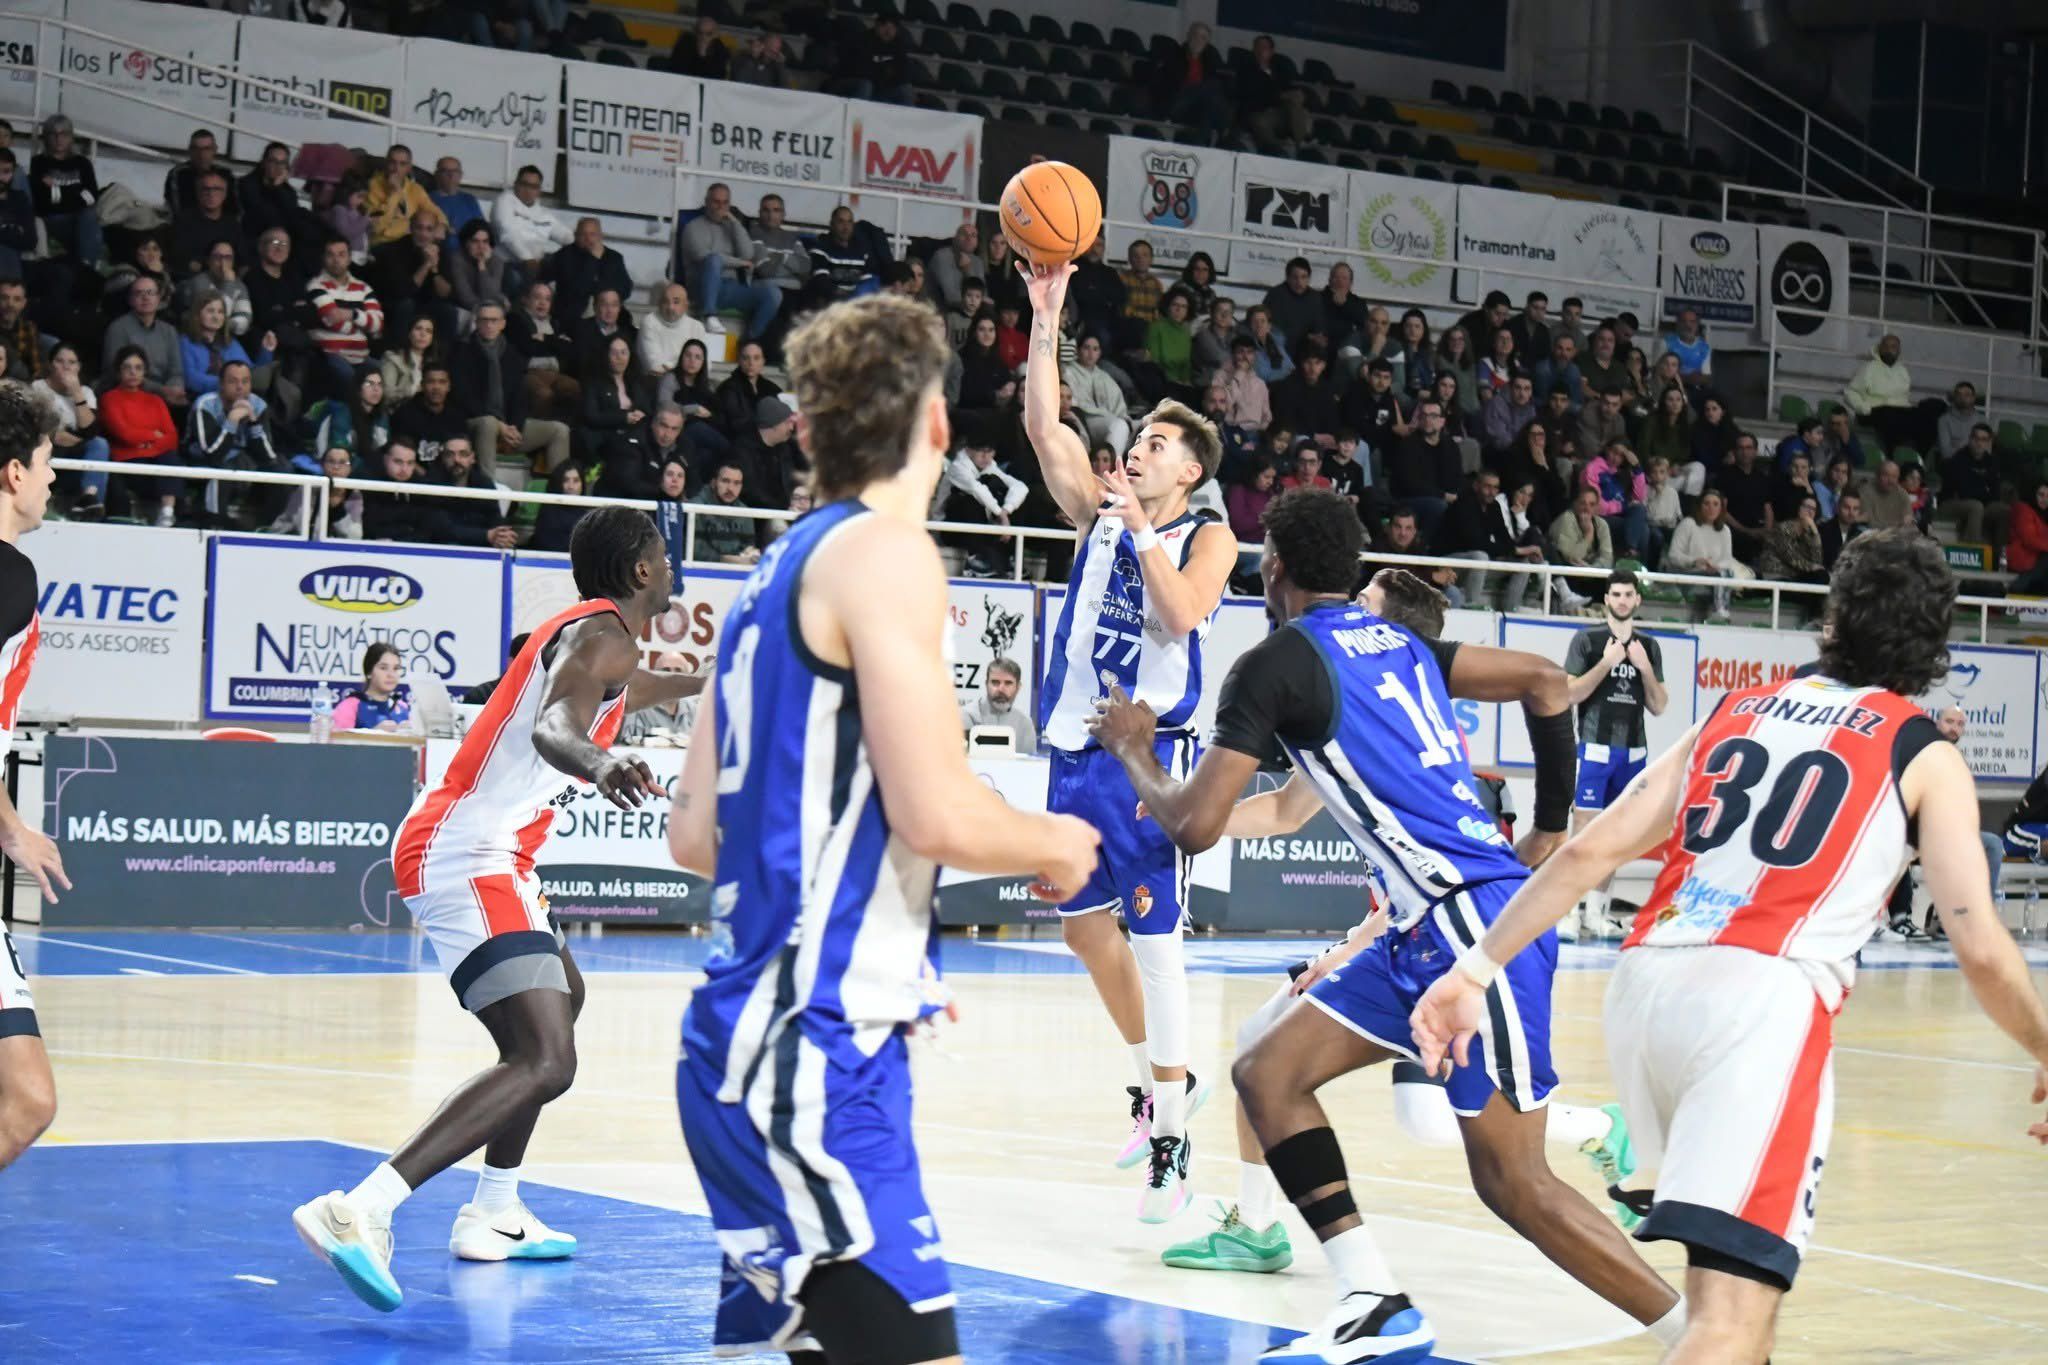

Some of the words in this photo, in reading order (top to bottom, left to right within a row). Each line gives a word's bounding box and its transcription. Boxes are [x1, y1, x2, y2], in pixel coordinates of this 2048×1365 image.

[0, 42, 35, 66] SA
[68, 47, 100, 73] los
[572, 97, 691, 137] ENTRENA
[571, 127, 622, 156] CON
[711, 122, 762, 150] BAR
[772, 131, 834, 159] FELIZ
[720, 153, 769, 174] Flores
[773, 163, 798, 179] del
[801, 163, 820, 182] Sil
[866, 140, 957, 184] MAV
[1151, 157, 1189, 175] RUTA
[1151, 180, 1191, 220] 98
[1464, 234, 1556, 261] tramontana
[1949, 551, 1982, 567] RURAL
[314, 575, 411, 604] VULCO
[80, 632, 170, 655] ASESORES
[1093, 625, 1142, 667] 77
[1697, 658, 1763, 691] GRUAS
[1374, 662, 1462, 769] 14
[1732, 696, 1886, 737] GONZALEZ
[1973, 747, 1989, 758] 987
[1992, 748, 2003, 758] 56
[2020, 749, 2029, 760] 73
[1684, 737, 1850, 868] 30
[68, 810, 128, 842] MÁS
[133, 816, 227, 844] SALUD.
[233, 813, 290, 845] MÁS
[295, 821, 390, 847] BIERZO
[1240, 835, 1286, 862] MÁS
[1289, 840, 1361, 864] SALUD.
[125, 854, 337, 877] www.clinicaponferrada.es
[541, 879, 597, 898] SALUD.
[599, 878, 632, 898] MÁS
[634, 882, 689, 898] BIERZO
[1000, 884, 1028, 901] MÁS
